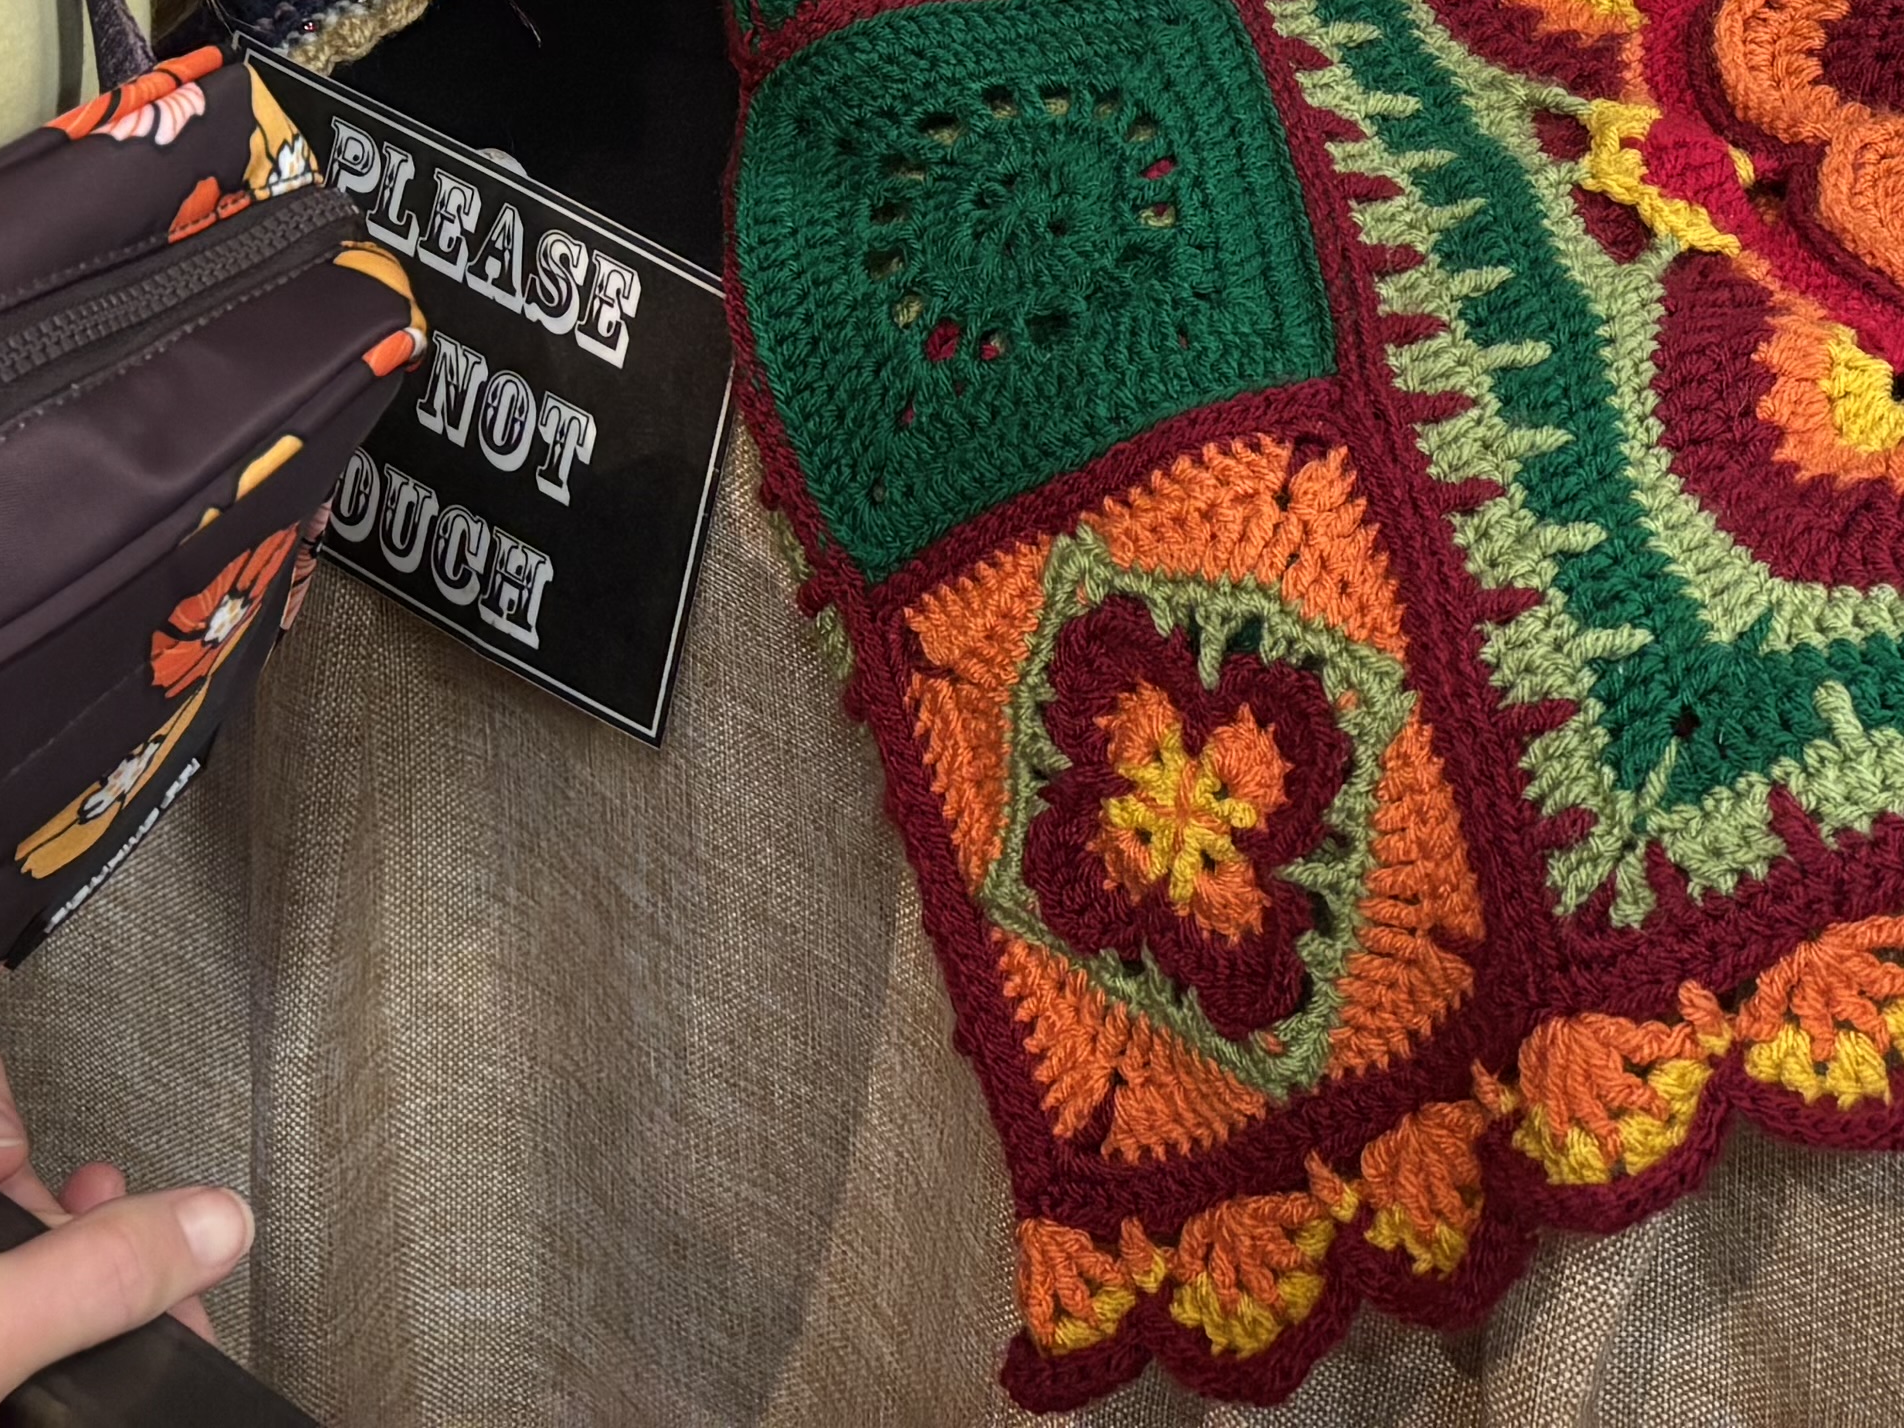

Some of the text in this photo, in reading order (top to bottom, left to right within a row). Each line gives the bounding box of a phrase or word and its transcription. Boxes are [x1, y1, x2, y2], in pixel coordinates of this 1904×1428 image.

[324, 115, 641, 369] PLEASE
[415, 330, 598, 506] NOT
[329, 446, 554, 650] OUCH
